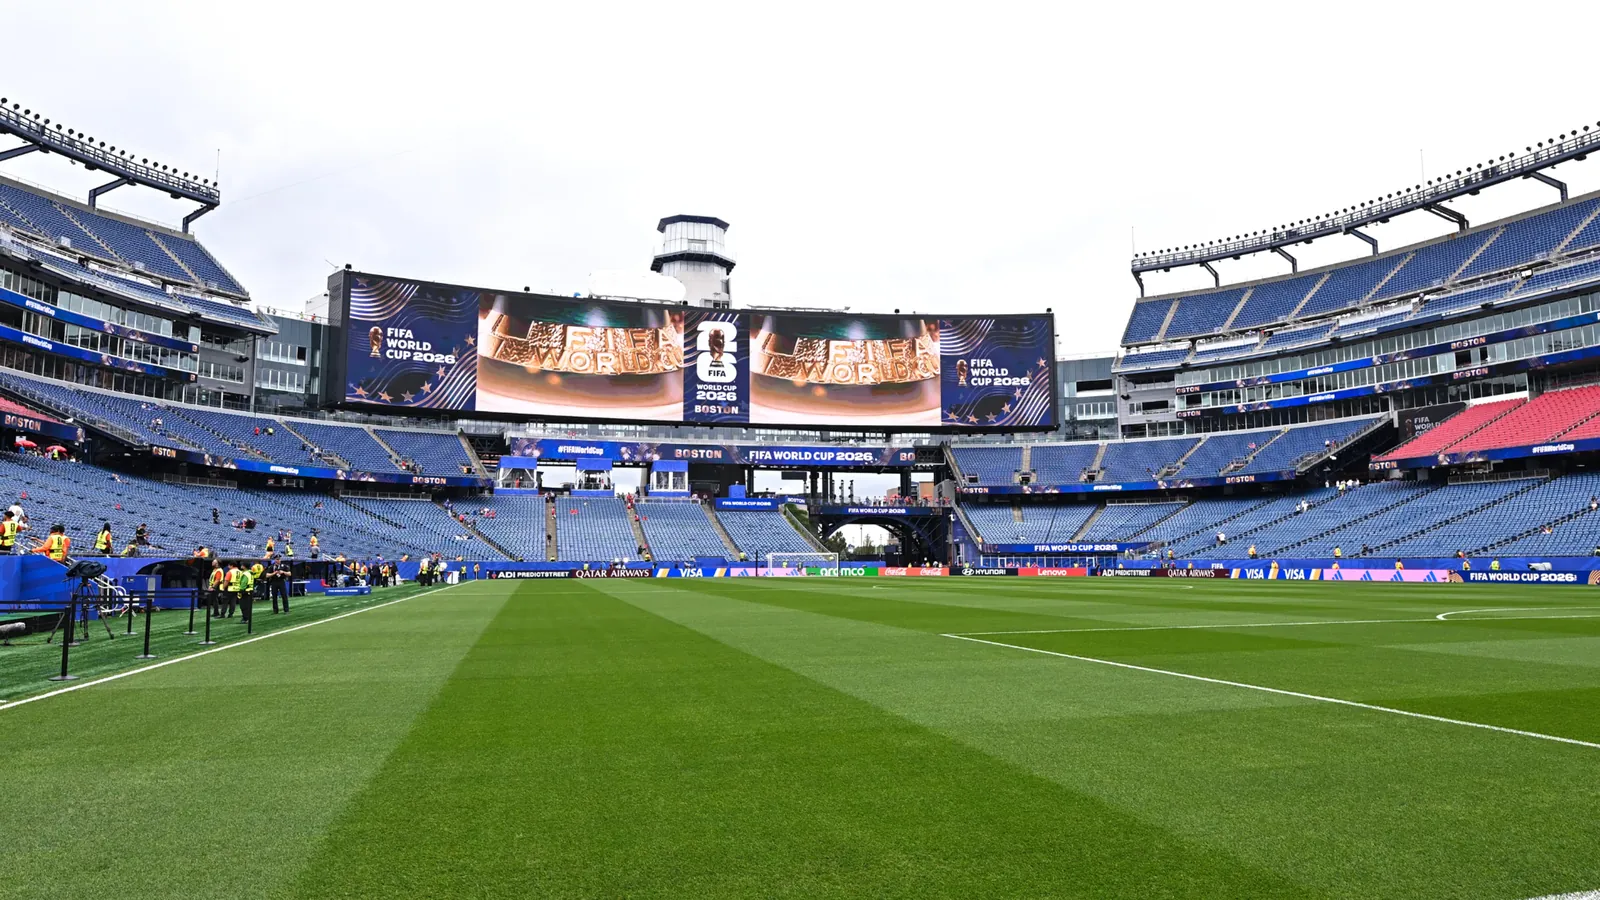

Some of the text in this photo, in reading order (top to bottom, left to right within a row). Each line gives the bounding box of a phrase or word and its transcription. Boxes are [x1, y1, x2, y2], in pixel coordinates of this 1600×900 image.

[387, 327, 414, 339] FIFA
[386, 338, 432, 351] WORLD
[1451, 337, 1486, 349] BOSTON
[385, 349, 456, 364] CUP 2026
[970, 359, 993, 367] FIFA
[970, 368, 1009, 376] WORLD
[1453, 367, 1489, 379] BOSTON
[970, 377, 1030, 386] CUP 2026
[696, 391, 737, 401] 2026
[694, 404, 739, 414] BOSTON
[4, 414, 42, 431] BOSTON
[1414, 416, 1430, 424] FIFA
[1414, 422, 1441, 430] WORLD
[557, 445, 604, 456] #FIFAWorldCup
[674, 449, 722, 459] BOSTON
[749, 451, 873, 461] FIFA WORLD CUP 2026
[412, 476, 447, 484] BOSTON
[1226, 475, 1255, 484] BOSTON
[575, 569, 650, 579] QATAR AIRWAYS
[679, 568, 703, 577] VISA
[1037, 568, 1067, 576] Lenovo
[1168, 569, 1215, 578] QATAR AIRWAYS
[1245, 568, 1264, 579] VISA
[1283, 569, 1305, 580] VISA
[1470, 572, 1488, 580] FIFA
[1488, 573, 1520, 581] WORLD
[1521, 573, 1540, 581] CUP
[1540, 573, 1574, 581] 2026
